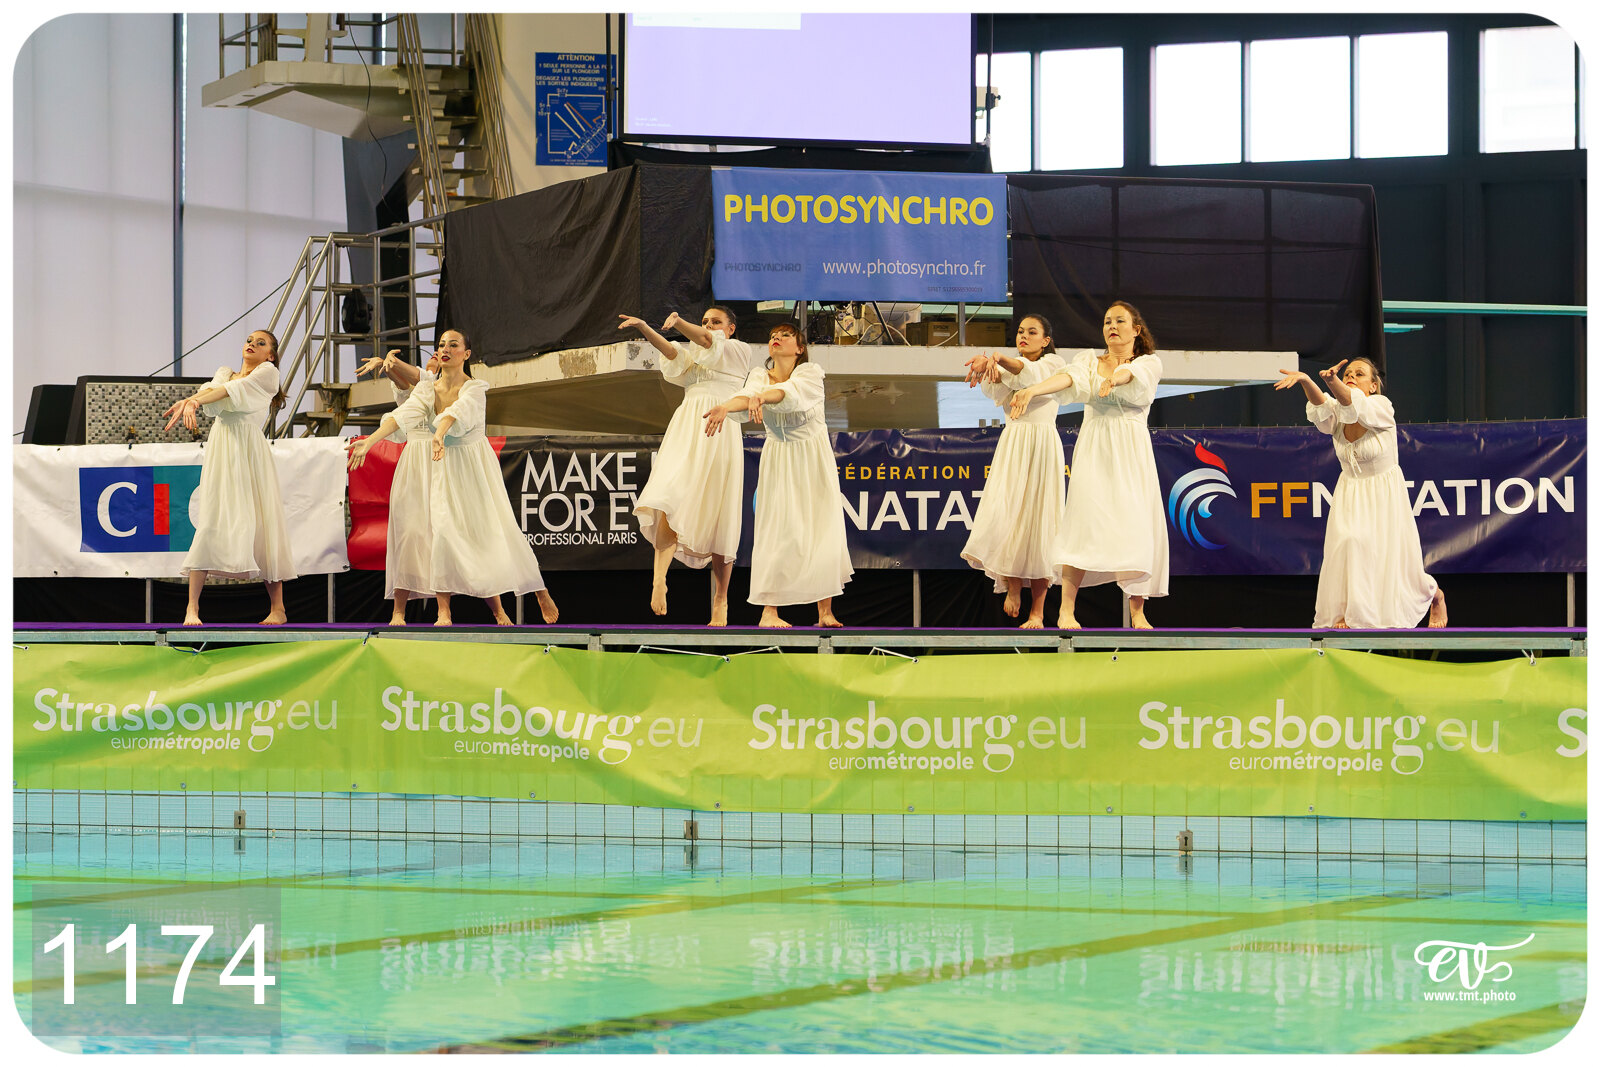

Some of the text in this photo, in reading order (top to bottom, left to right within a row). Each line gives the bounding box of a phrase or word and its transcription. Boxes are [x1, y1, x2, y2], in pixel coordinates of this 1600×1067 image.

[724, 194, 994, 226] PHOTOSYNCHRO
[822, 259, 986, 279] www.photosynchro.fr
[521, 451, 638, 493] MAKE
[96, 481, 201, 538] CI
[521, 492, 598, 532] FOR
[1250, 475, 1575, 519] FFNATION
[607, 531, 638, 545] PARIS
[32, 687, 338, 752] Strasbourg.eu
[380, 685, 704, 765] Strasbourg.eu
[747, 700, 1087, 773] Strasbourg.eu
[1137, 698, 1499, 775] Strasbourg.eu
[110, 732, 241, 755] eurométropole
[454, 737, 590, 763] eurométropole
[828, 750, 974, 775] eurométropole
[1229, 750, 1383, 776] eurométropole
